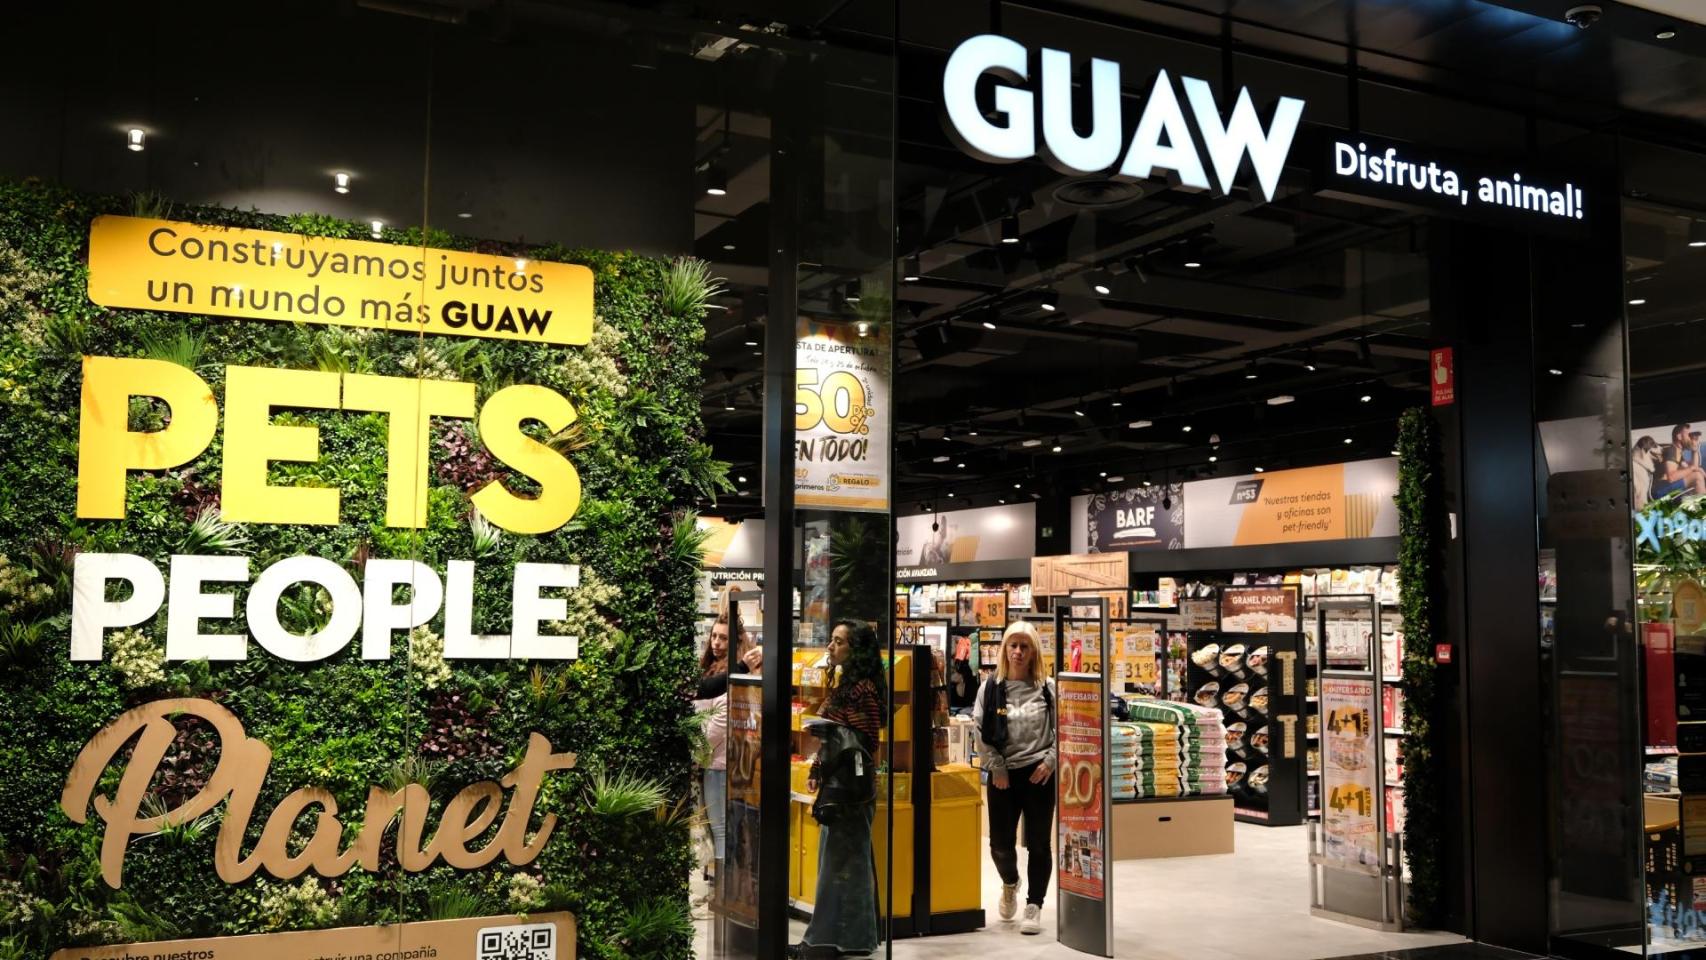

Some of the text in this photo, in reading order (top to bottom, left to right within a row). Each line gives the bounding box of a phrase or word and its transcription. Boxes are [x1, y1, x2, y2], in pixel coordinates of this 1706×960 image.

[943, 34, 1305, 203] GUAW
[1335, 142, 1584, 219] Disfruta, animal!
[148, 228, 544, 294] Construyamos juntos
[147, 279, 553, 336] un mundo más GUAW
[796, 368, 867, 435] 50
[76, 355, 583, 535] PETS
[819, 435, 868, 463] TODO!
[843, 478, 870, 486] REGALO
[1301, 491, 1331, 502] tiendas
[1116, 505, 1155, 528] BARF
[1277, 506, 1331, 520] y oficinas son
[912, 568, 937, 577] AVANZADA
[70, 552, 580, 662] PEOPLE
[988, 603, 998, 616] 18
[1232, 595, 1285, 605] GRANEL POINT
[1327, 710, 1362, 738] 4+1
[61, 697, 577, 890] Planet
[1329, 785, 1365, 817] 4+1
